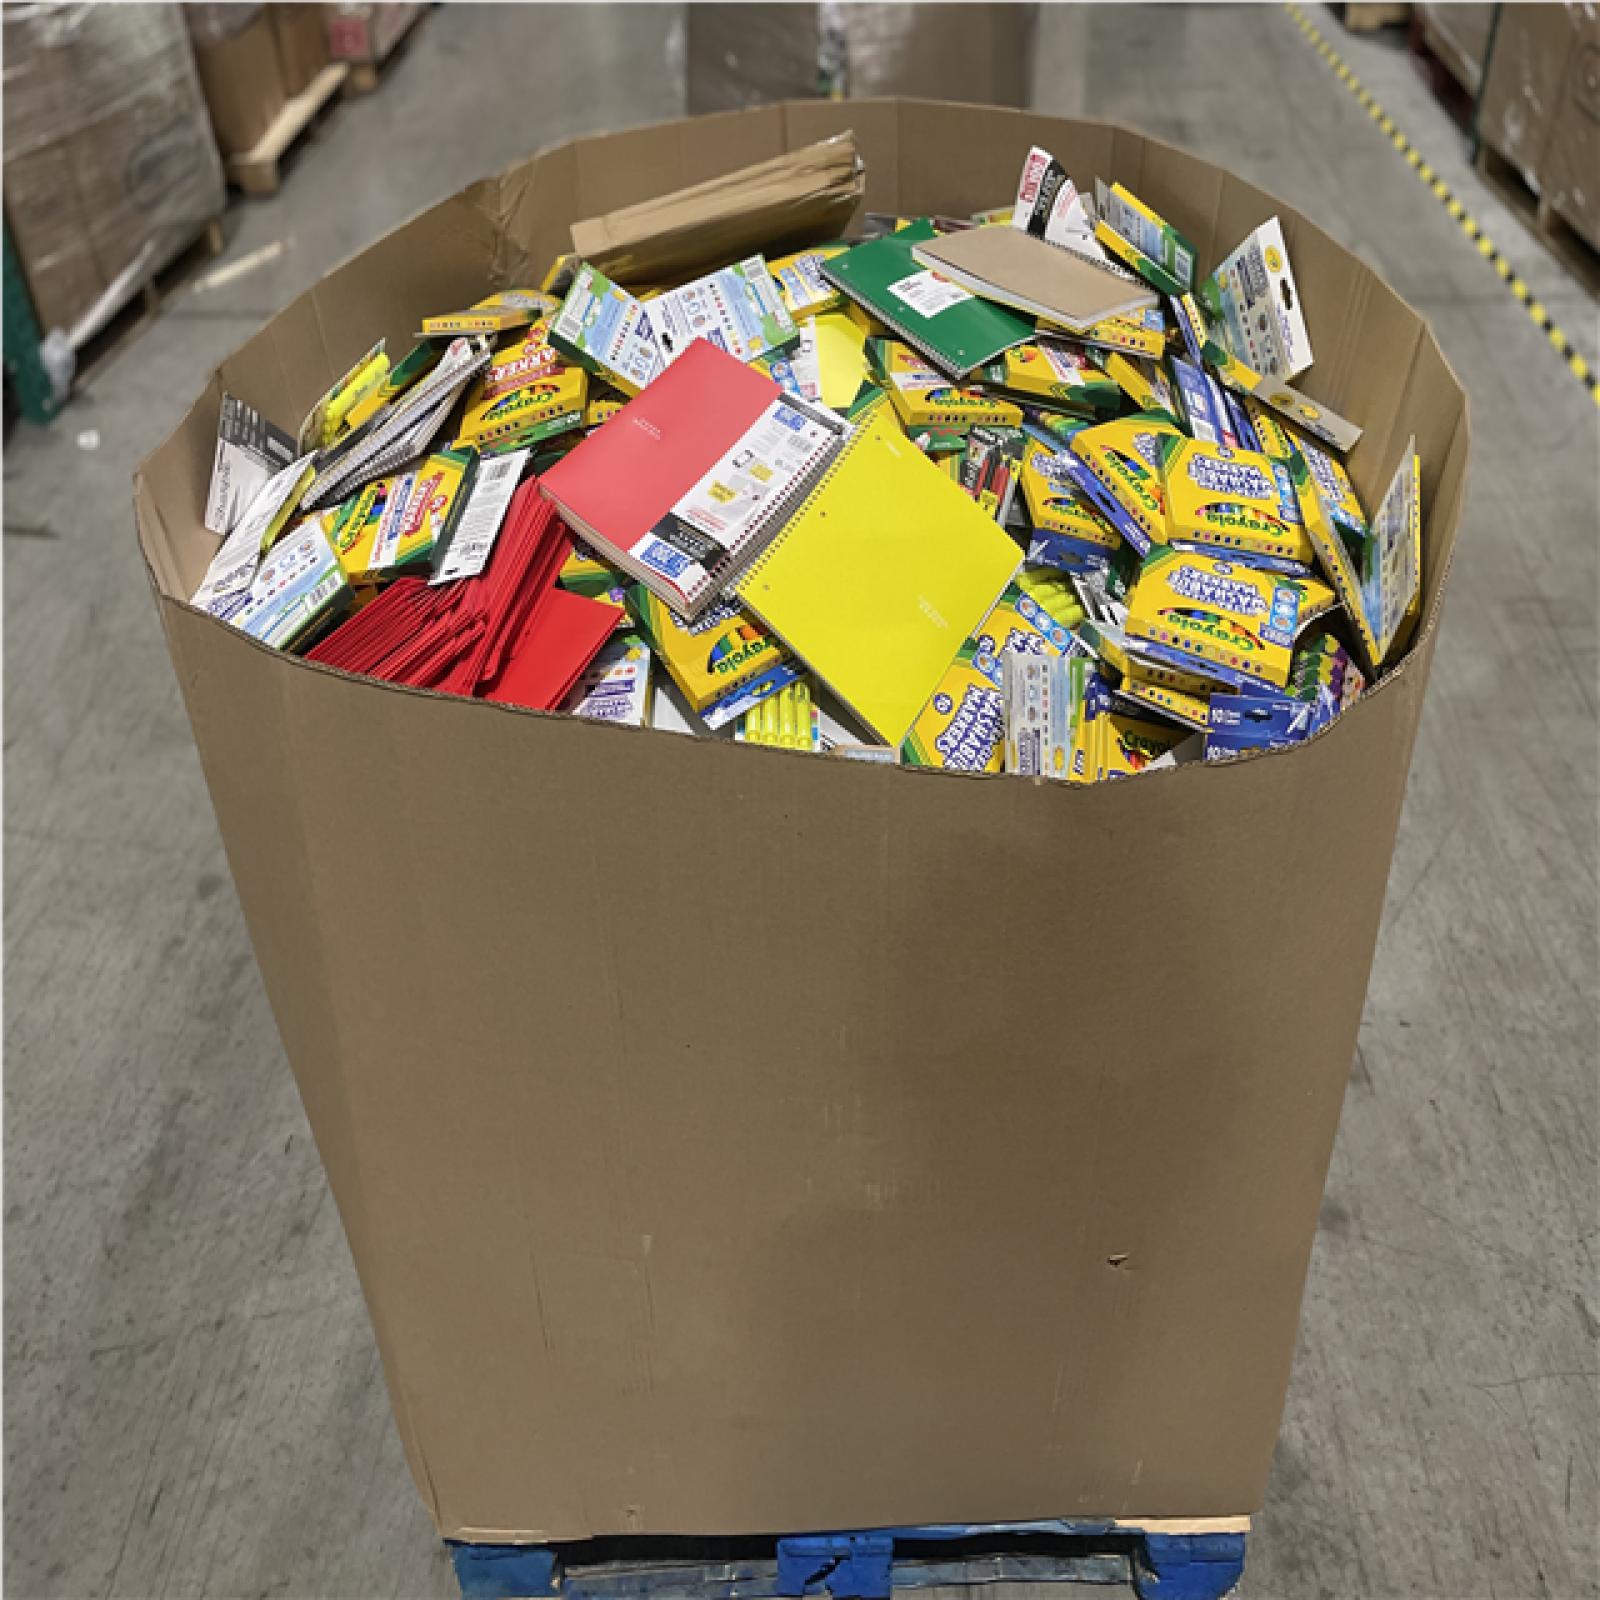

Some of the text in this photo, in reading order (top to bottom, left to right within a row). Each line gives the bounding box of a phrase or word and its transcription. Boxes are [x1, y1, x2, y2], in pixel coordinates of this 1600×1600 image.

[1103, 450, 1158, 514] Crayola
[1205, 512, 1284, 537] Crayola
[1167, 614, 1255, 652] Crayola
[937, 684, 986, 755] MARKERS
